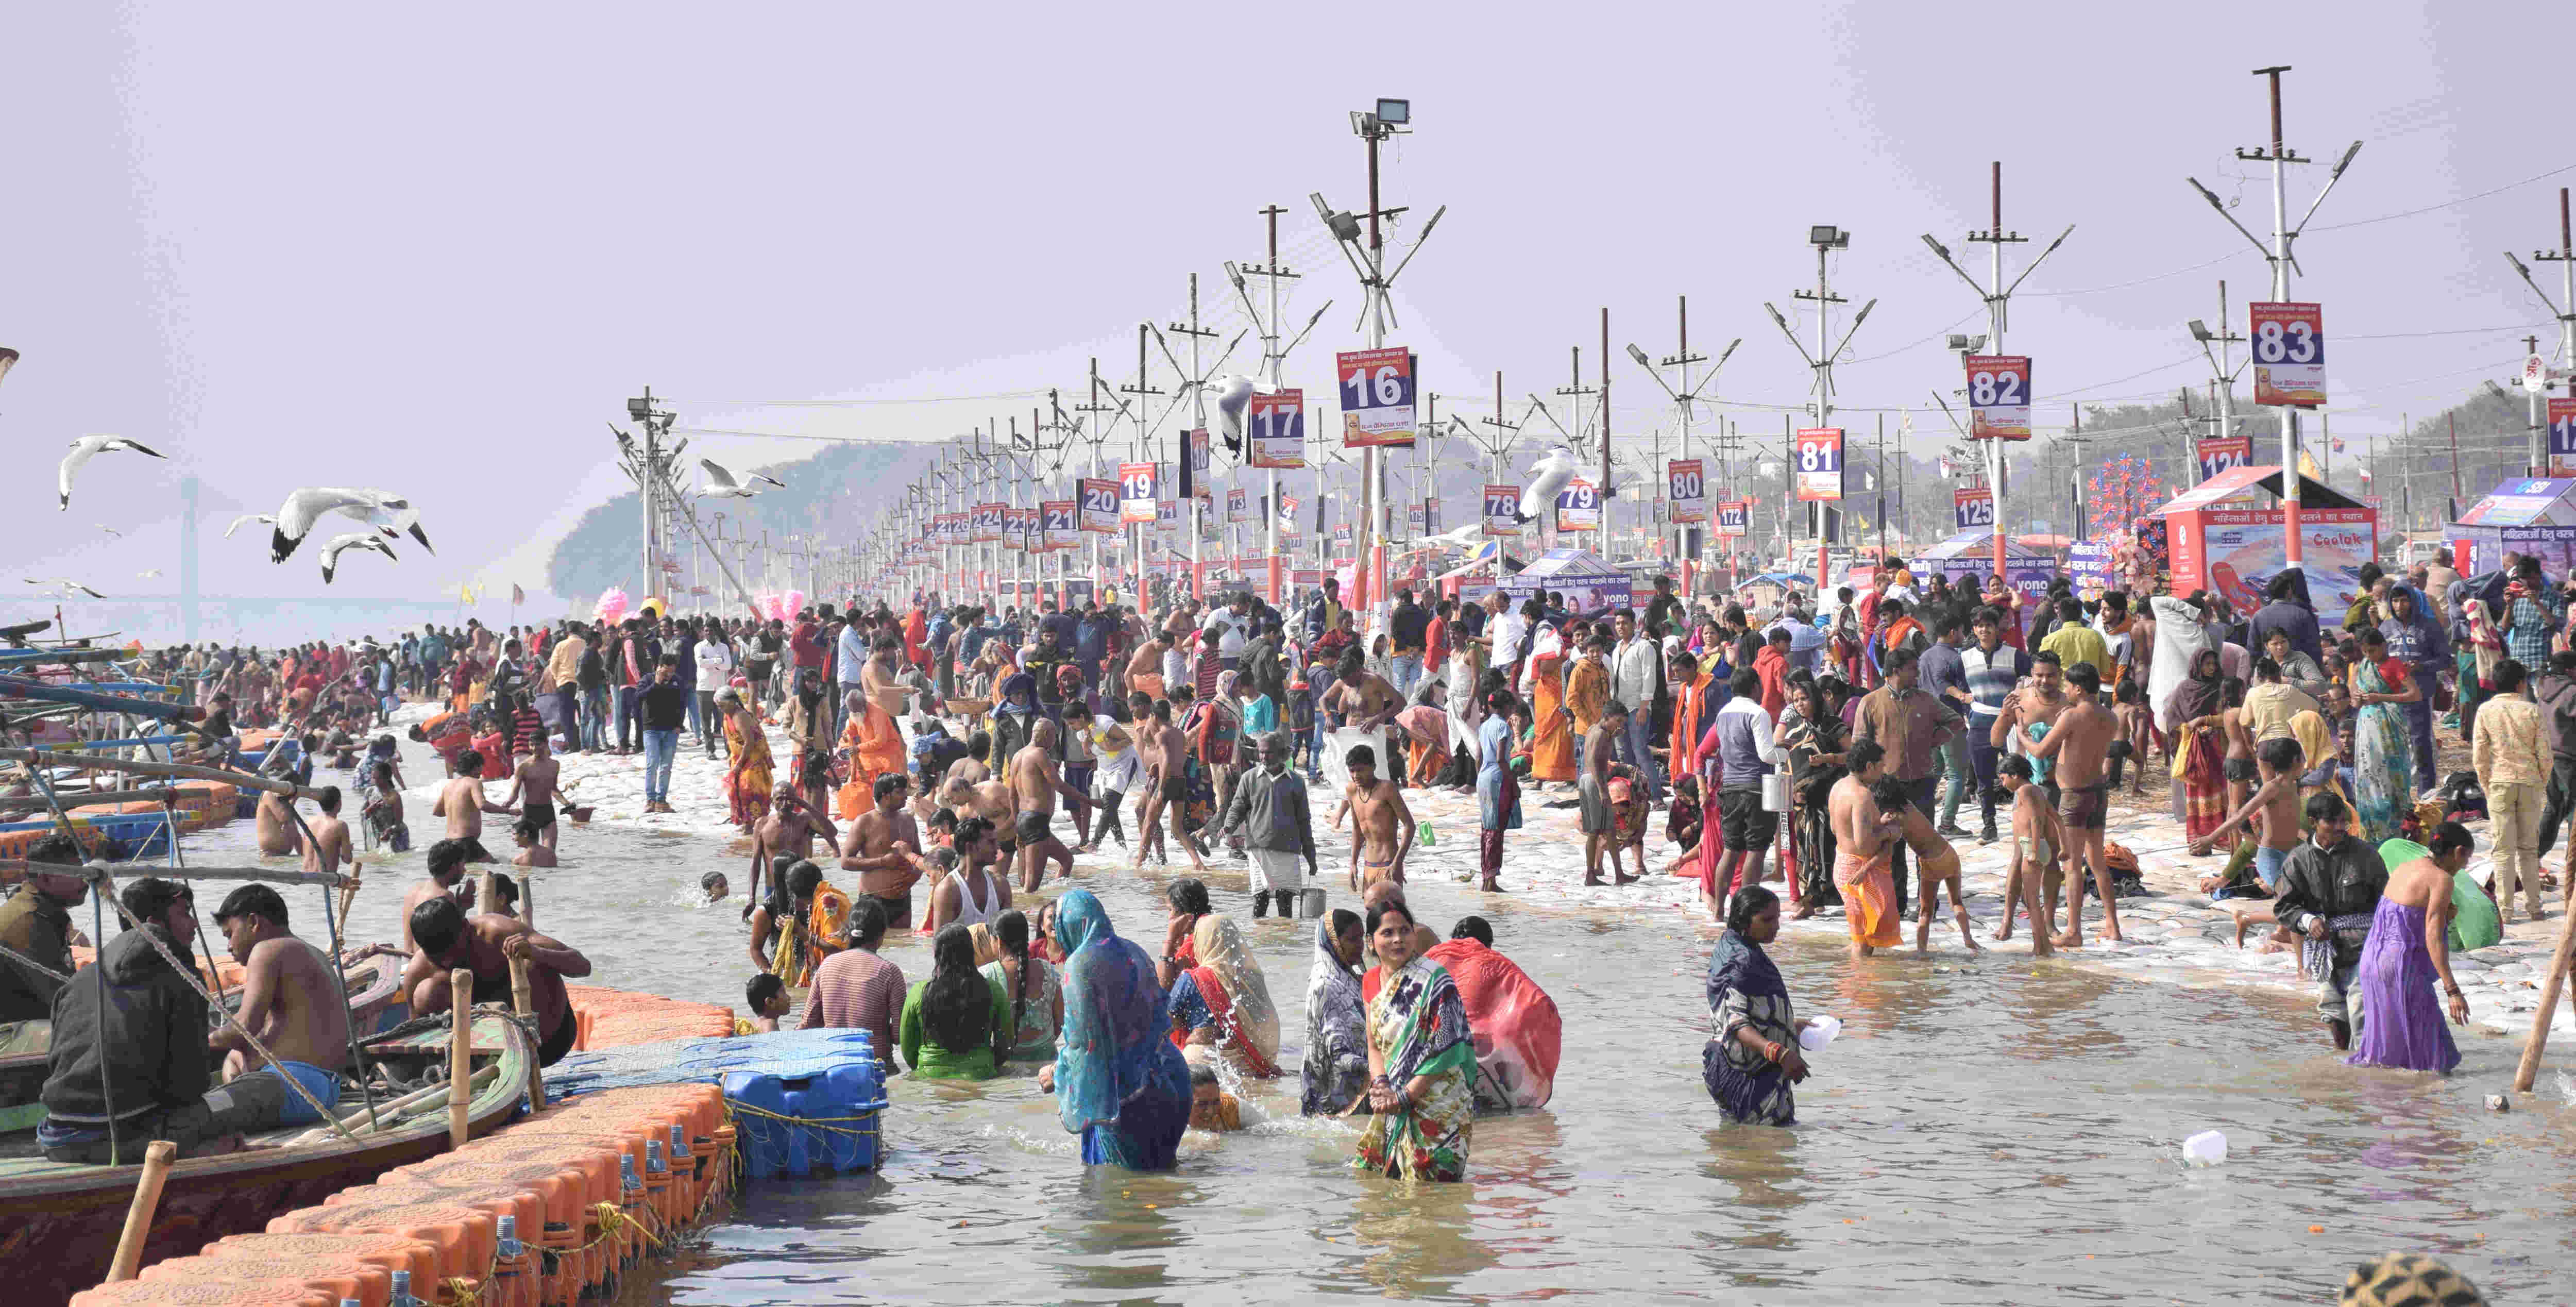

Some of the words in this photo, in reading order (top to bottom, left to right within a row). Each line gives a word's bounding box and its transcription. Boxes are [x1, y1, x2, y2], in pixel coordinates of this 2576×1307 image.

[2258, 321, 2315, 363] 83
[1348, 366, 1402, 407] 16
[1973, 371, 2022, 405] 82
[1257, 404, 1298, 437] 17
[1193, 441, 1208, 470] 18
[1802, 441, 1832, 471] 81
[1124, 474, 1150, 499] 19
[1565, 485, 1594, 508] 79
[1673, 472, 1700, 499] 80
[1086, 488, 1115, 512] 20
[1231, 495, 1246, 510] 73
[1488, 495, 1516, 516] 78
[1959, 498, 1993, 524] 125
[953, 520, 969, 532] 26
[1048, 509, 1074, 529] 21
[1721, 508, 1742, 524] 172
[2502, 527, 2539, 540] महिलाओं
[2540, 527, 2555, 541] हेतु
[2016, 580, 2048, 593] yono
[1603, 594, 1629, 606] yono
